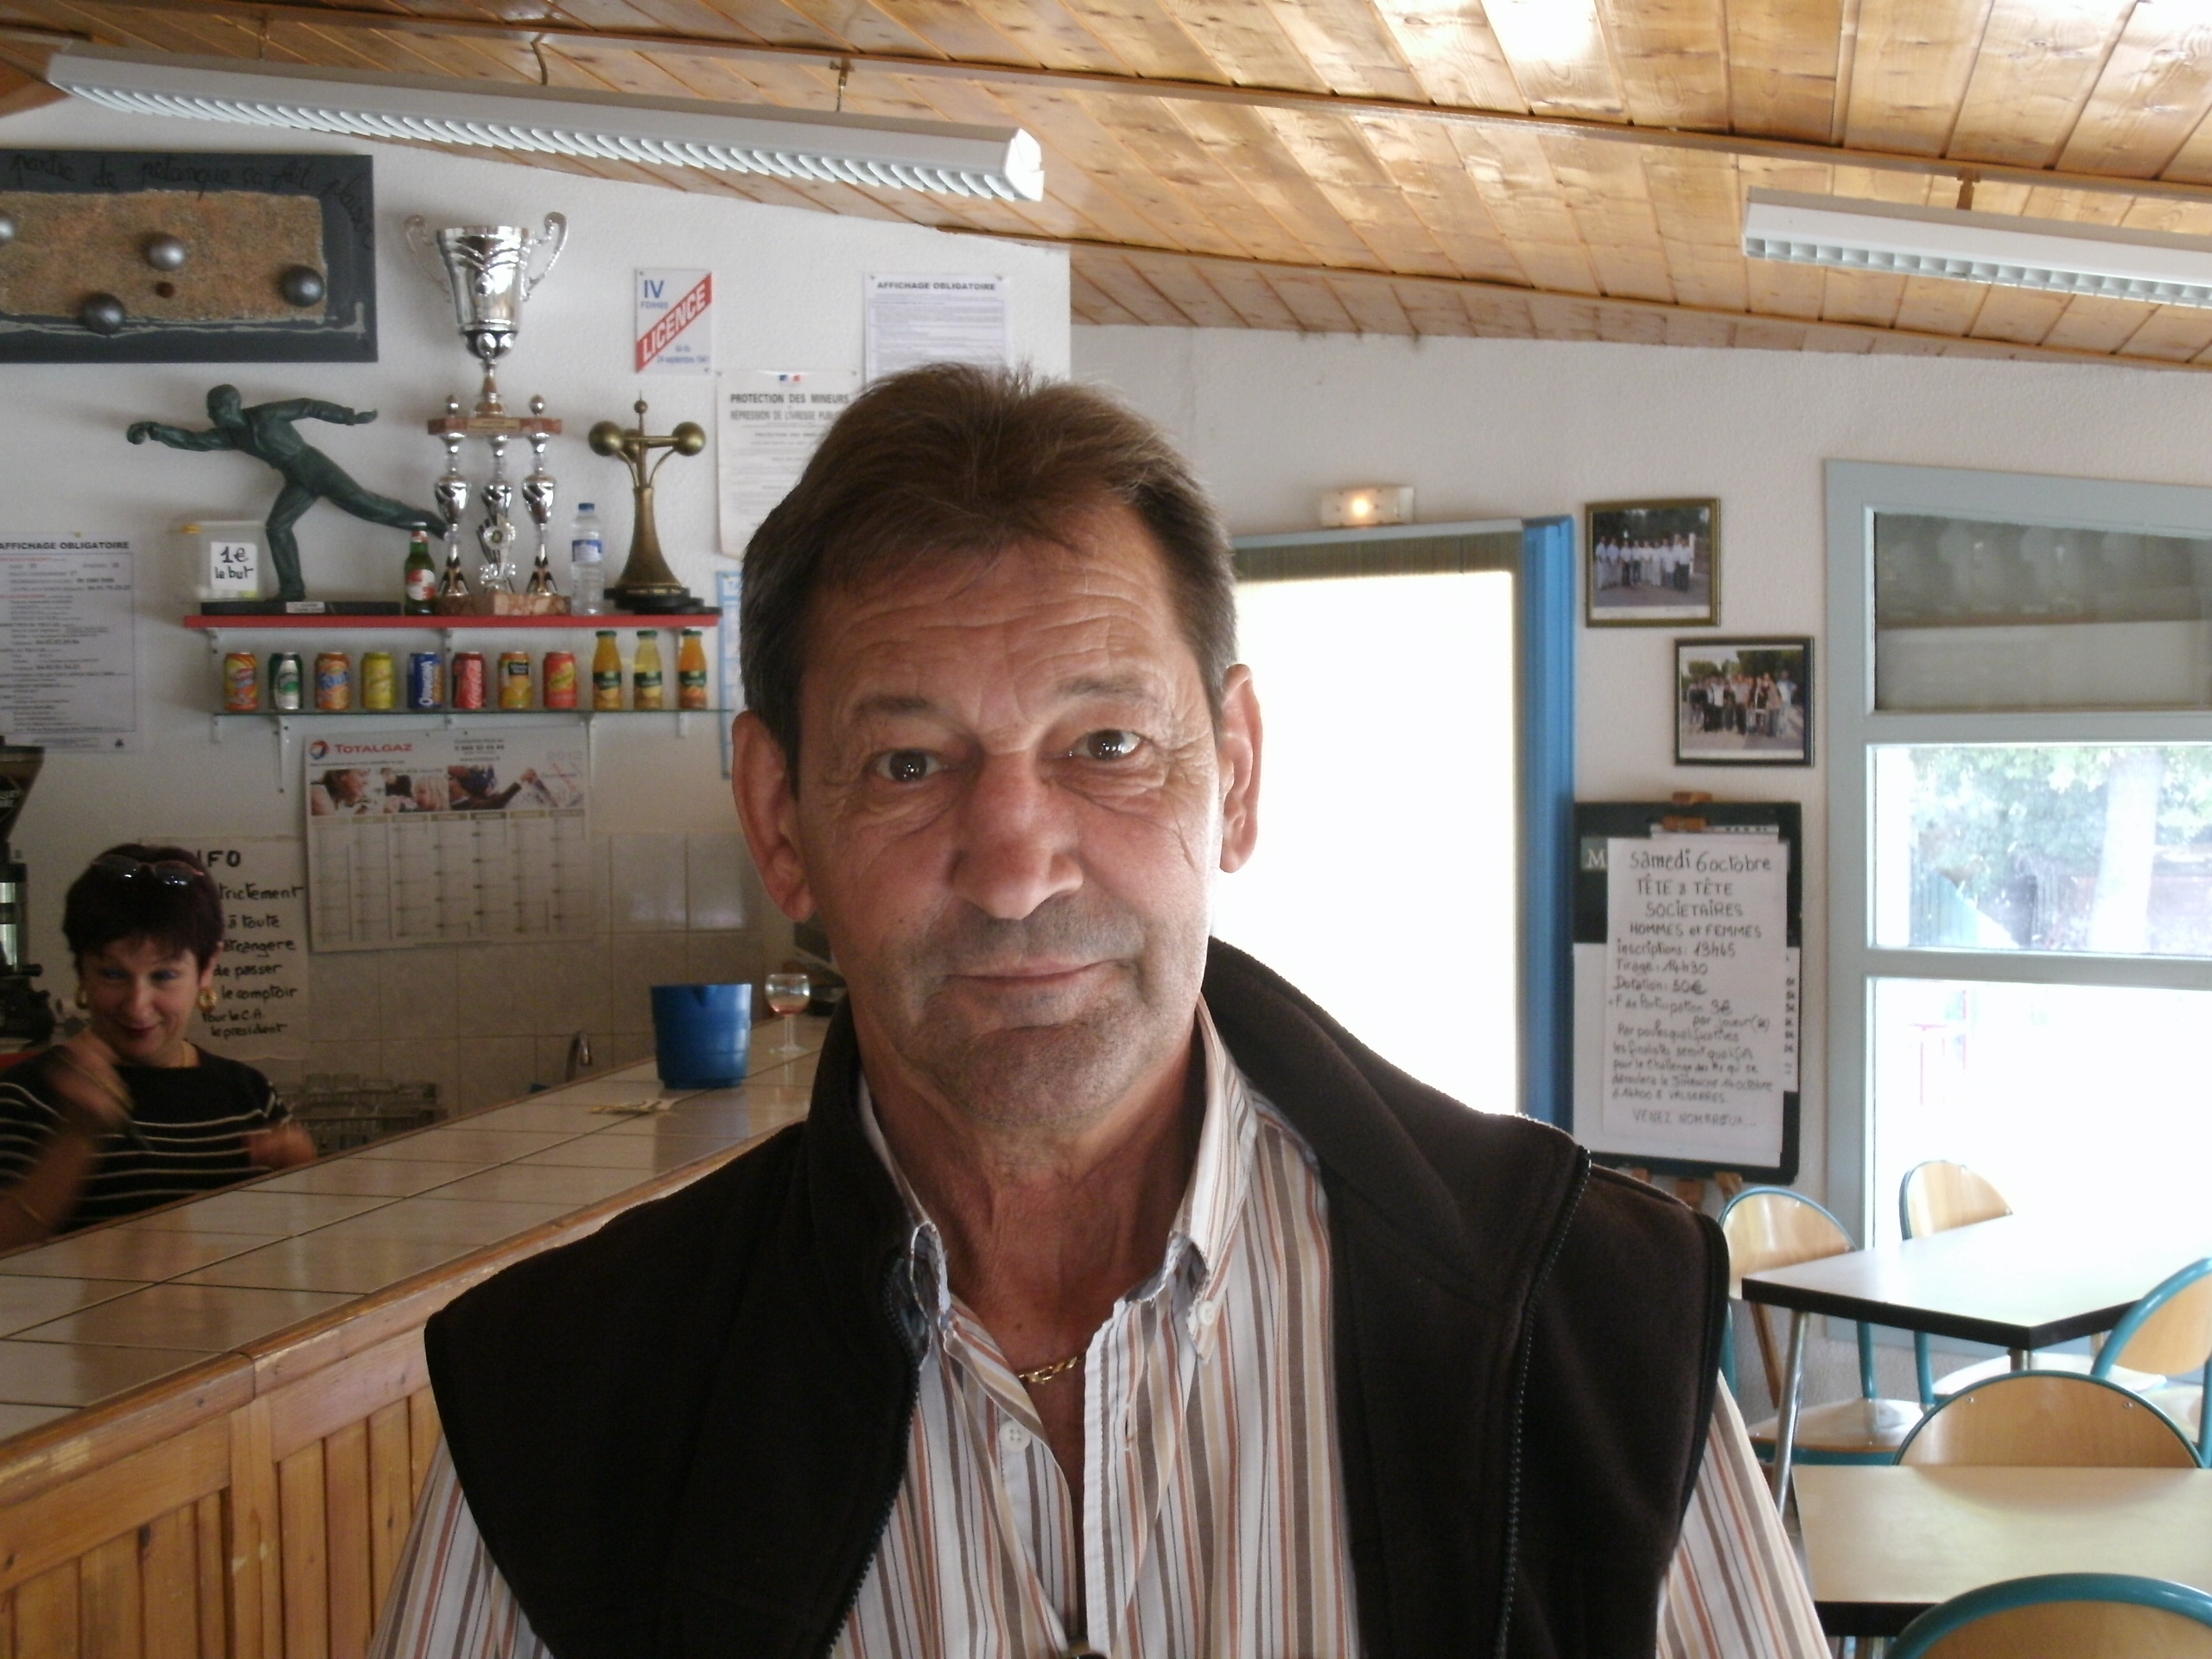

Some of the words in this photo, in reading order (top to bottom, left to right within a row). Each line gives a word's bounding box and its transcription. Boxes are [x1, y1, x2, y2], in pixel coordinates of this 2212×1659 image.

[644, 279, 664, 298] IV
[877, 282, 930, 290] AFFICHAGE
[932, 282, 996, 291] OBLIGATOIRE
[642, 282, 707, 363] LICENCE
[730, 393, 785, 404] PROTECTION
[789, 393, 806, 404] DES
[810, 393, 850, 404] MINEURS
[60, 540, 130, 550] OBLIGATOIRE
[220, 545, 249, 563] 1€
[214, 566, 225, 580] le
[227, 565, 253, 581] but
[334, 743, 413, 753] TOTALGAZ
[1696, 850, 1710, 873] 6
[1709, 854, 1771, 874] octobre
[242, 913, 281, 930] toute
[1630, 922, 1683, 938] HOMMES
[1689, 925, 1701, 937] et
[1705, 925, 1763, 939] FEMMES
[234, 963, 283, 980] passer
[221, 985, 233, 1000] le
[235, 984, 298, 1003] comptoir
